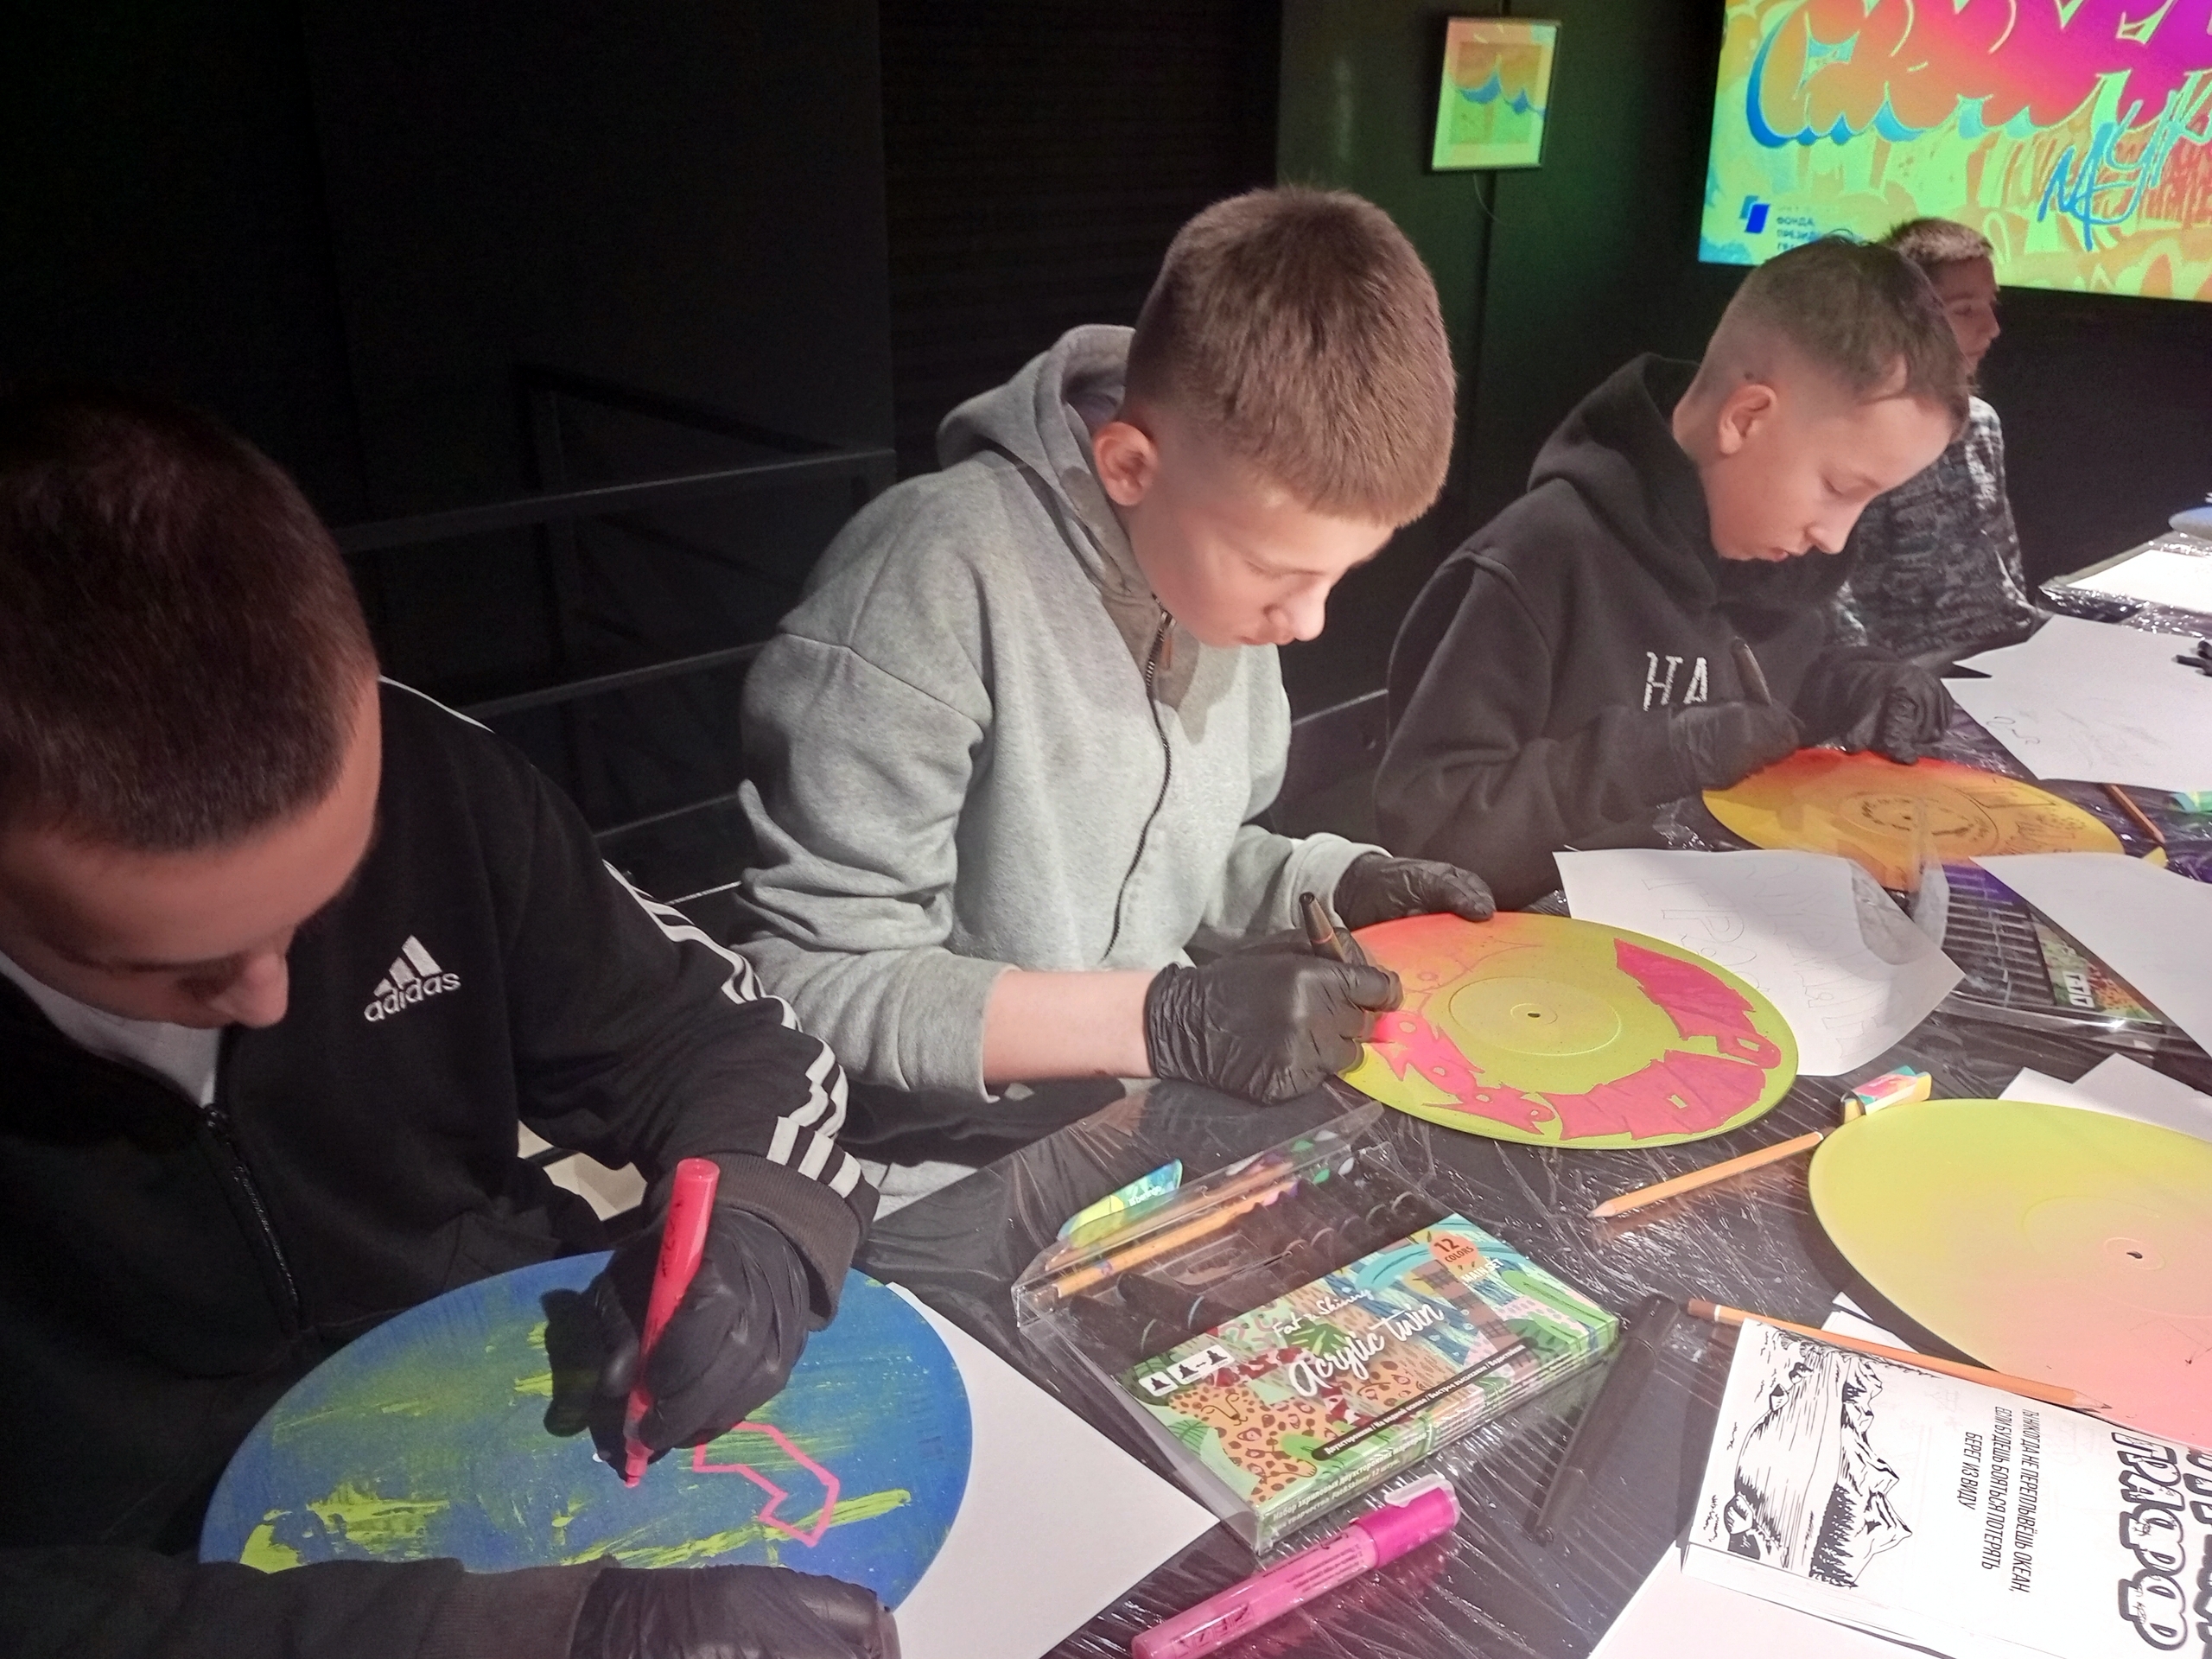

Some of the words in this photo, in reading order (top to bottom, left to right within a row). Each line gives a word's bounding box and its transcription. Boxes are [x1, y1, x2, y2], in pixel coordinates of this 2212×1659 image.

[1777, 216, 1815, 226] ФОНДА
[364, 973, 461, 1022] adidas
[1434, 1238, 1459, 1253] 12
[1445, 1247, 1474, 1262] COLORS
[1460, 1267, 1488, 1284] MAIN
[1484, 1258, 1503, 1272] SET
[1272, 1312, 1302, 1338] Fat
[1316, 1288, 1375, 1316] Skinny
[1369, 1303, 1445, 1342] twin
[1994, 1407, 2012, 1427] ЕСЛИ
[2021, 1408, 2039, 1420] ТЫ
[1963, 1432, 1982, 1463] БЕРЕГ
[1992, 1425, 2012, 1462] БУДЕШЬ
[2020, 1417, 2040, 1454] НИКОГДА
[1961, 1462, 1980, 1478] ИЗ
[2021, 1454, 2039, 1470] НЕ
[1273, 1503, 1297, 1522] Набор
[1298, 1482, 1339, 1508] акриловых
[1957, 1477, 1979, 1510] ВИДУ
[1987, 1464, 2009, 1513] БОЯТЬСЯ
[2014, 1468, 2039, 1549] ПЕРЕПЛЫВЁШЬ
[1981, 1512, 2005, 1569] ПОТЕРЯТЬ
[2009, 1551, 2032, 1592] ОКЕАН,
